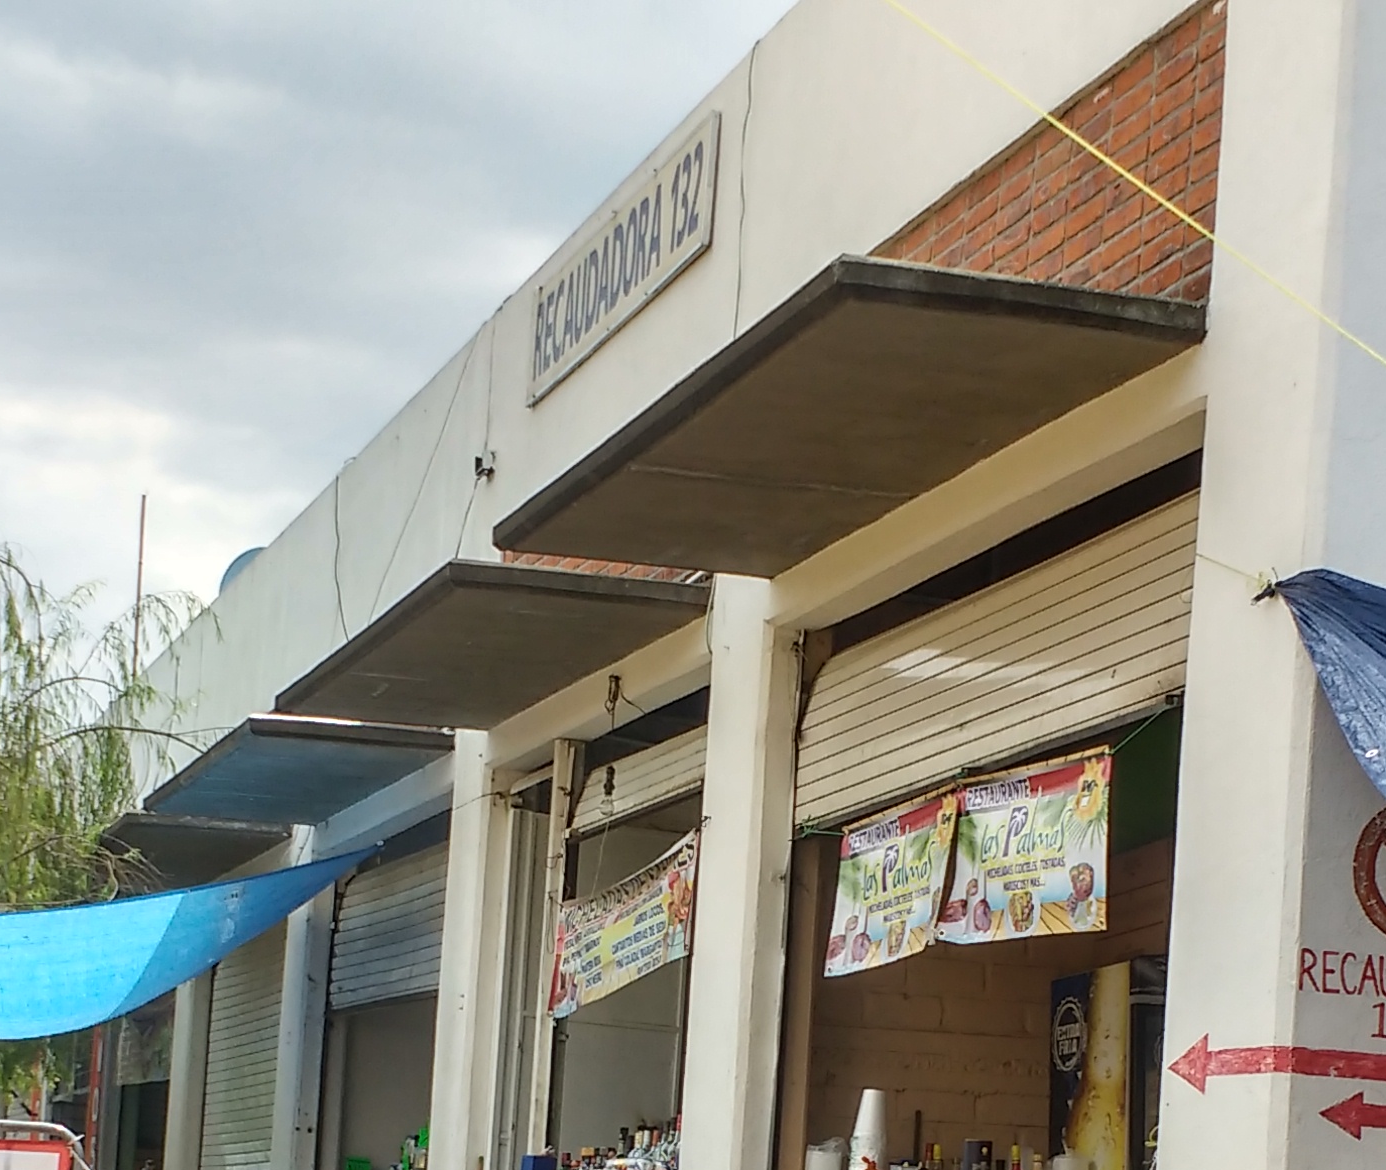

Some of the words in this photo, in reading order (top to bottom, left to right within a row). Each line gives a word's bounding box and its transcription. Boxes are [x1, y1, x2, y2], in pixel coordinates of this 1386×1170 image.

[532, 183, 663, 382] RECAUDADORA
[670, 140, 704, 254] 132
[967, 778, 1030, 808] RESTAURANTE
[849, 820, 900, 851] RESTAURANTE
